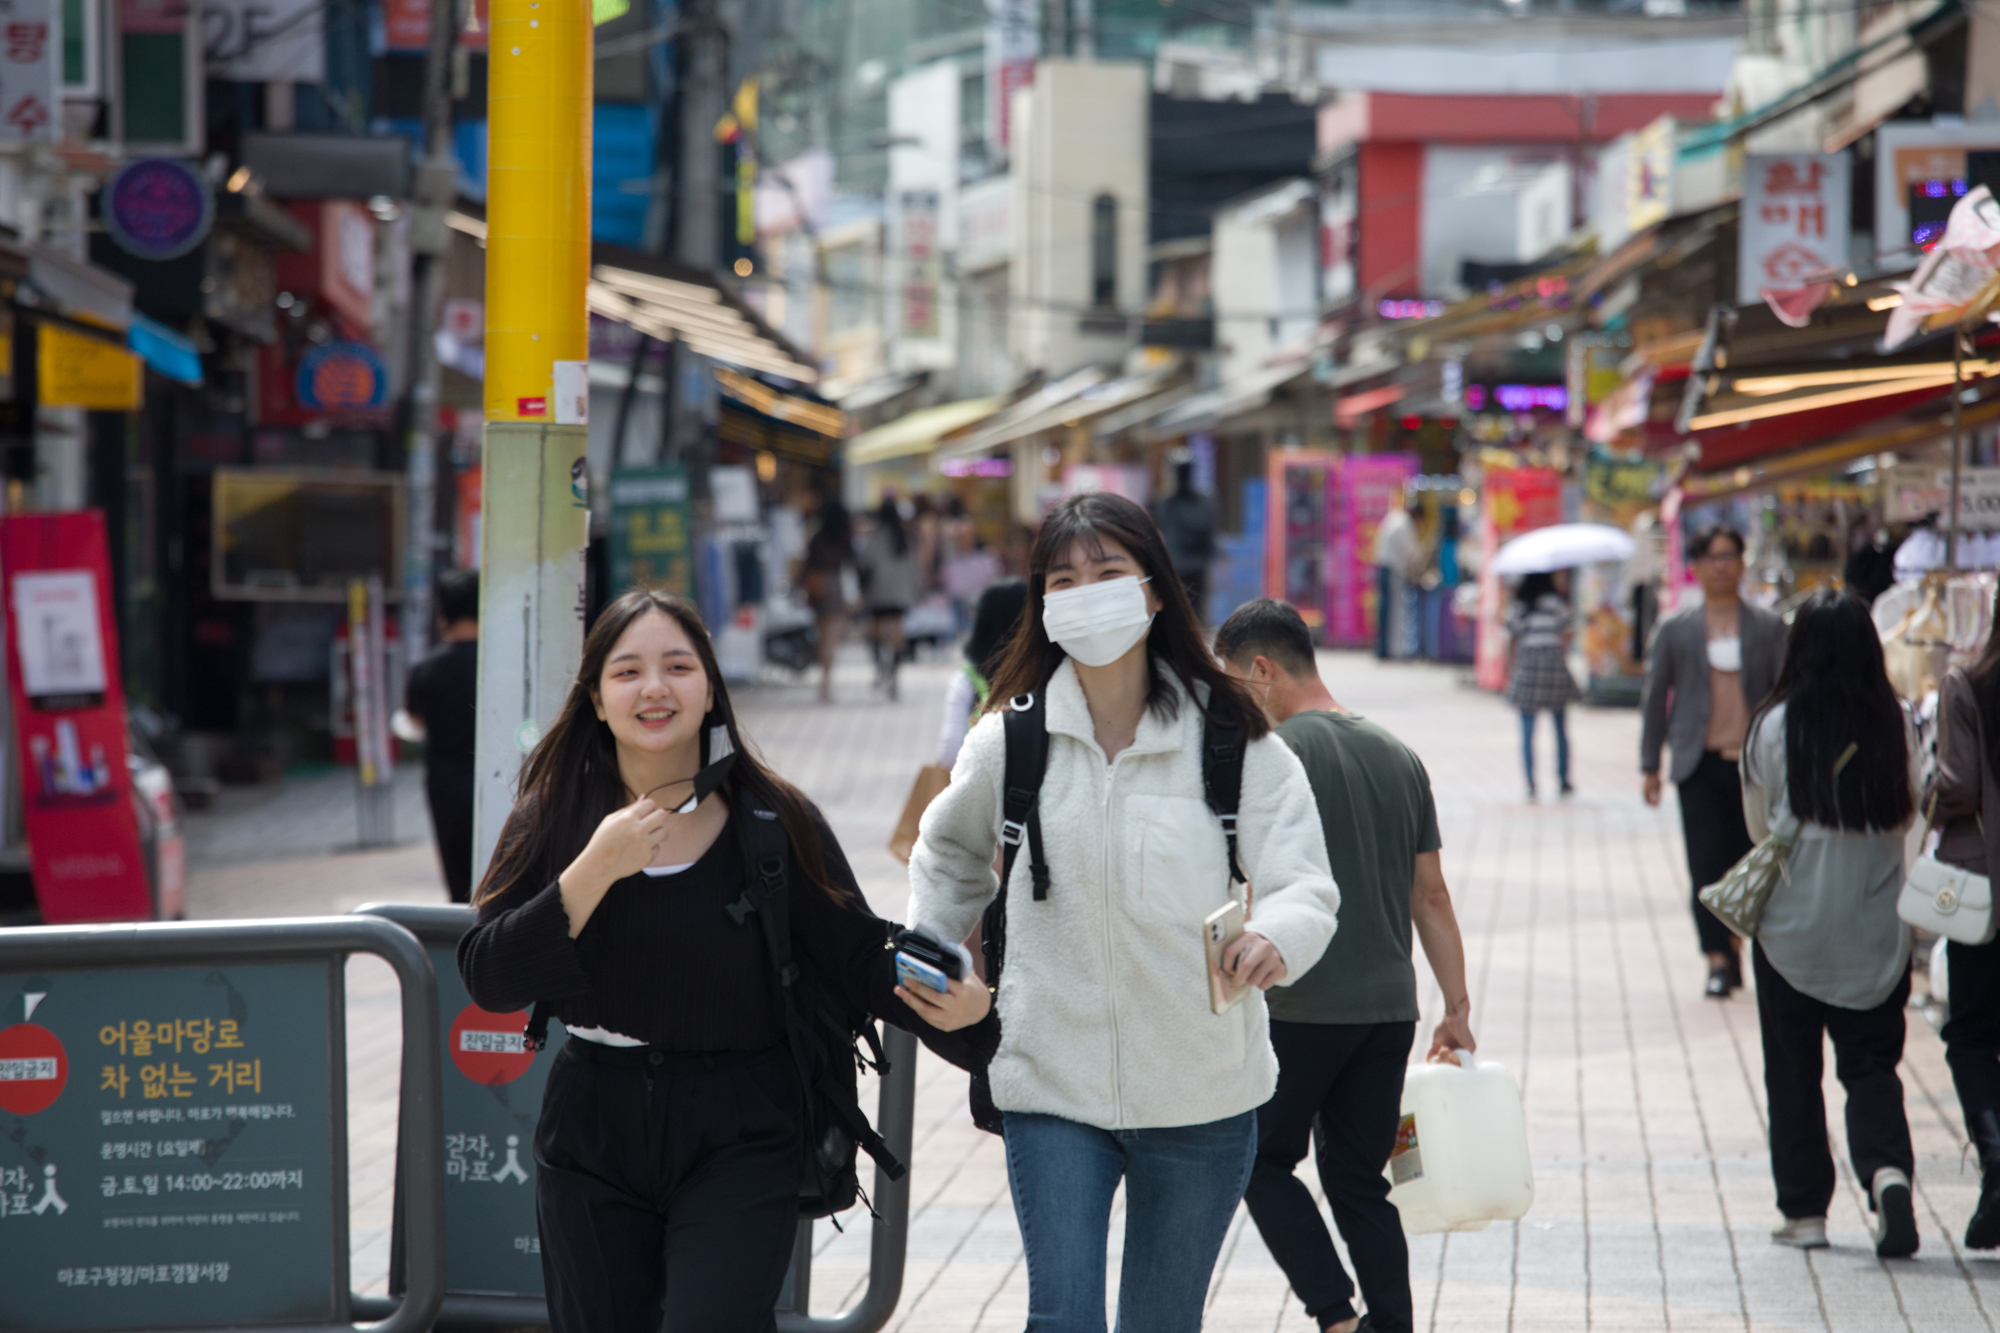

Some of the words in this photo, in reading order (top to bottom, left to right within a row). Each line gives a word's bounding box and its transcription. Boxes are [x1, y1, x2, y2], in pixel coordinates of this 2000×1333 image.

[99, 1018, 244, 1056] 어울마당로
[465, 1033, 522, 1052] 진입금지
[100, 1062, 131, 1099] 차
[140, 1061, 197, 1099] 없는
[208, 1057, 262, 1095] 거리
[101, 1140, 152, 1160] 운영시간
[445, 1133, 495, 1160] 걷자,
[0, 1165, 35, 1193] 자,
[165, 1169, 303, 1193] 14:00~22:00까지
[446, 1157, 491, 1183] 마포
[57, 1261, 230, 1287] 마포구청장/마포경찰서장
